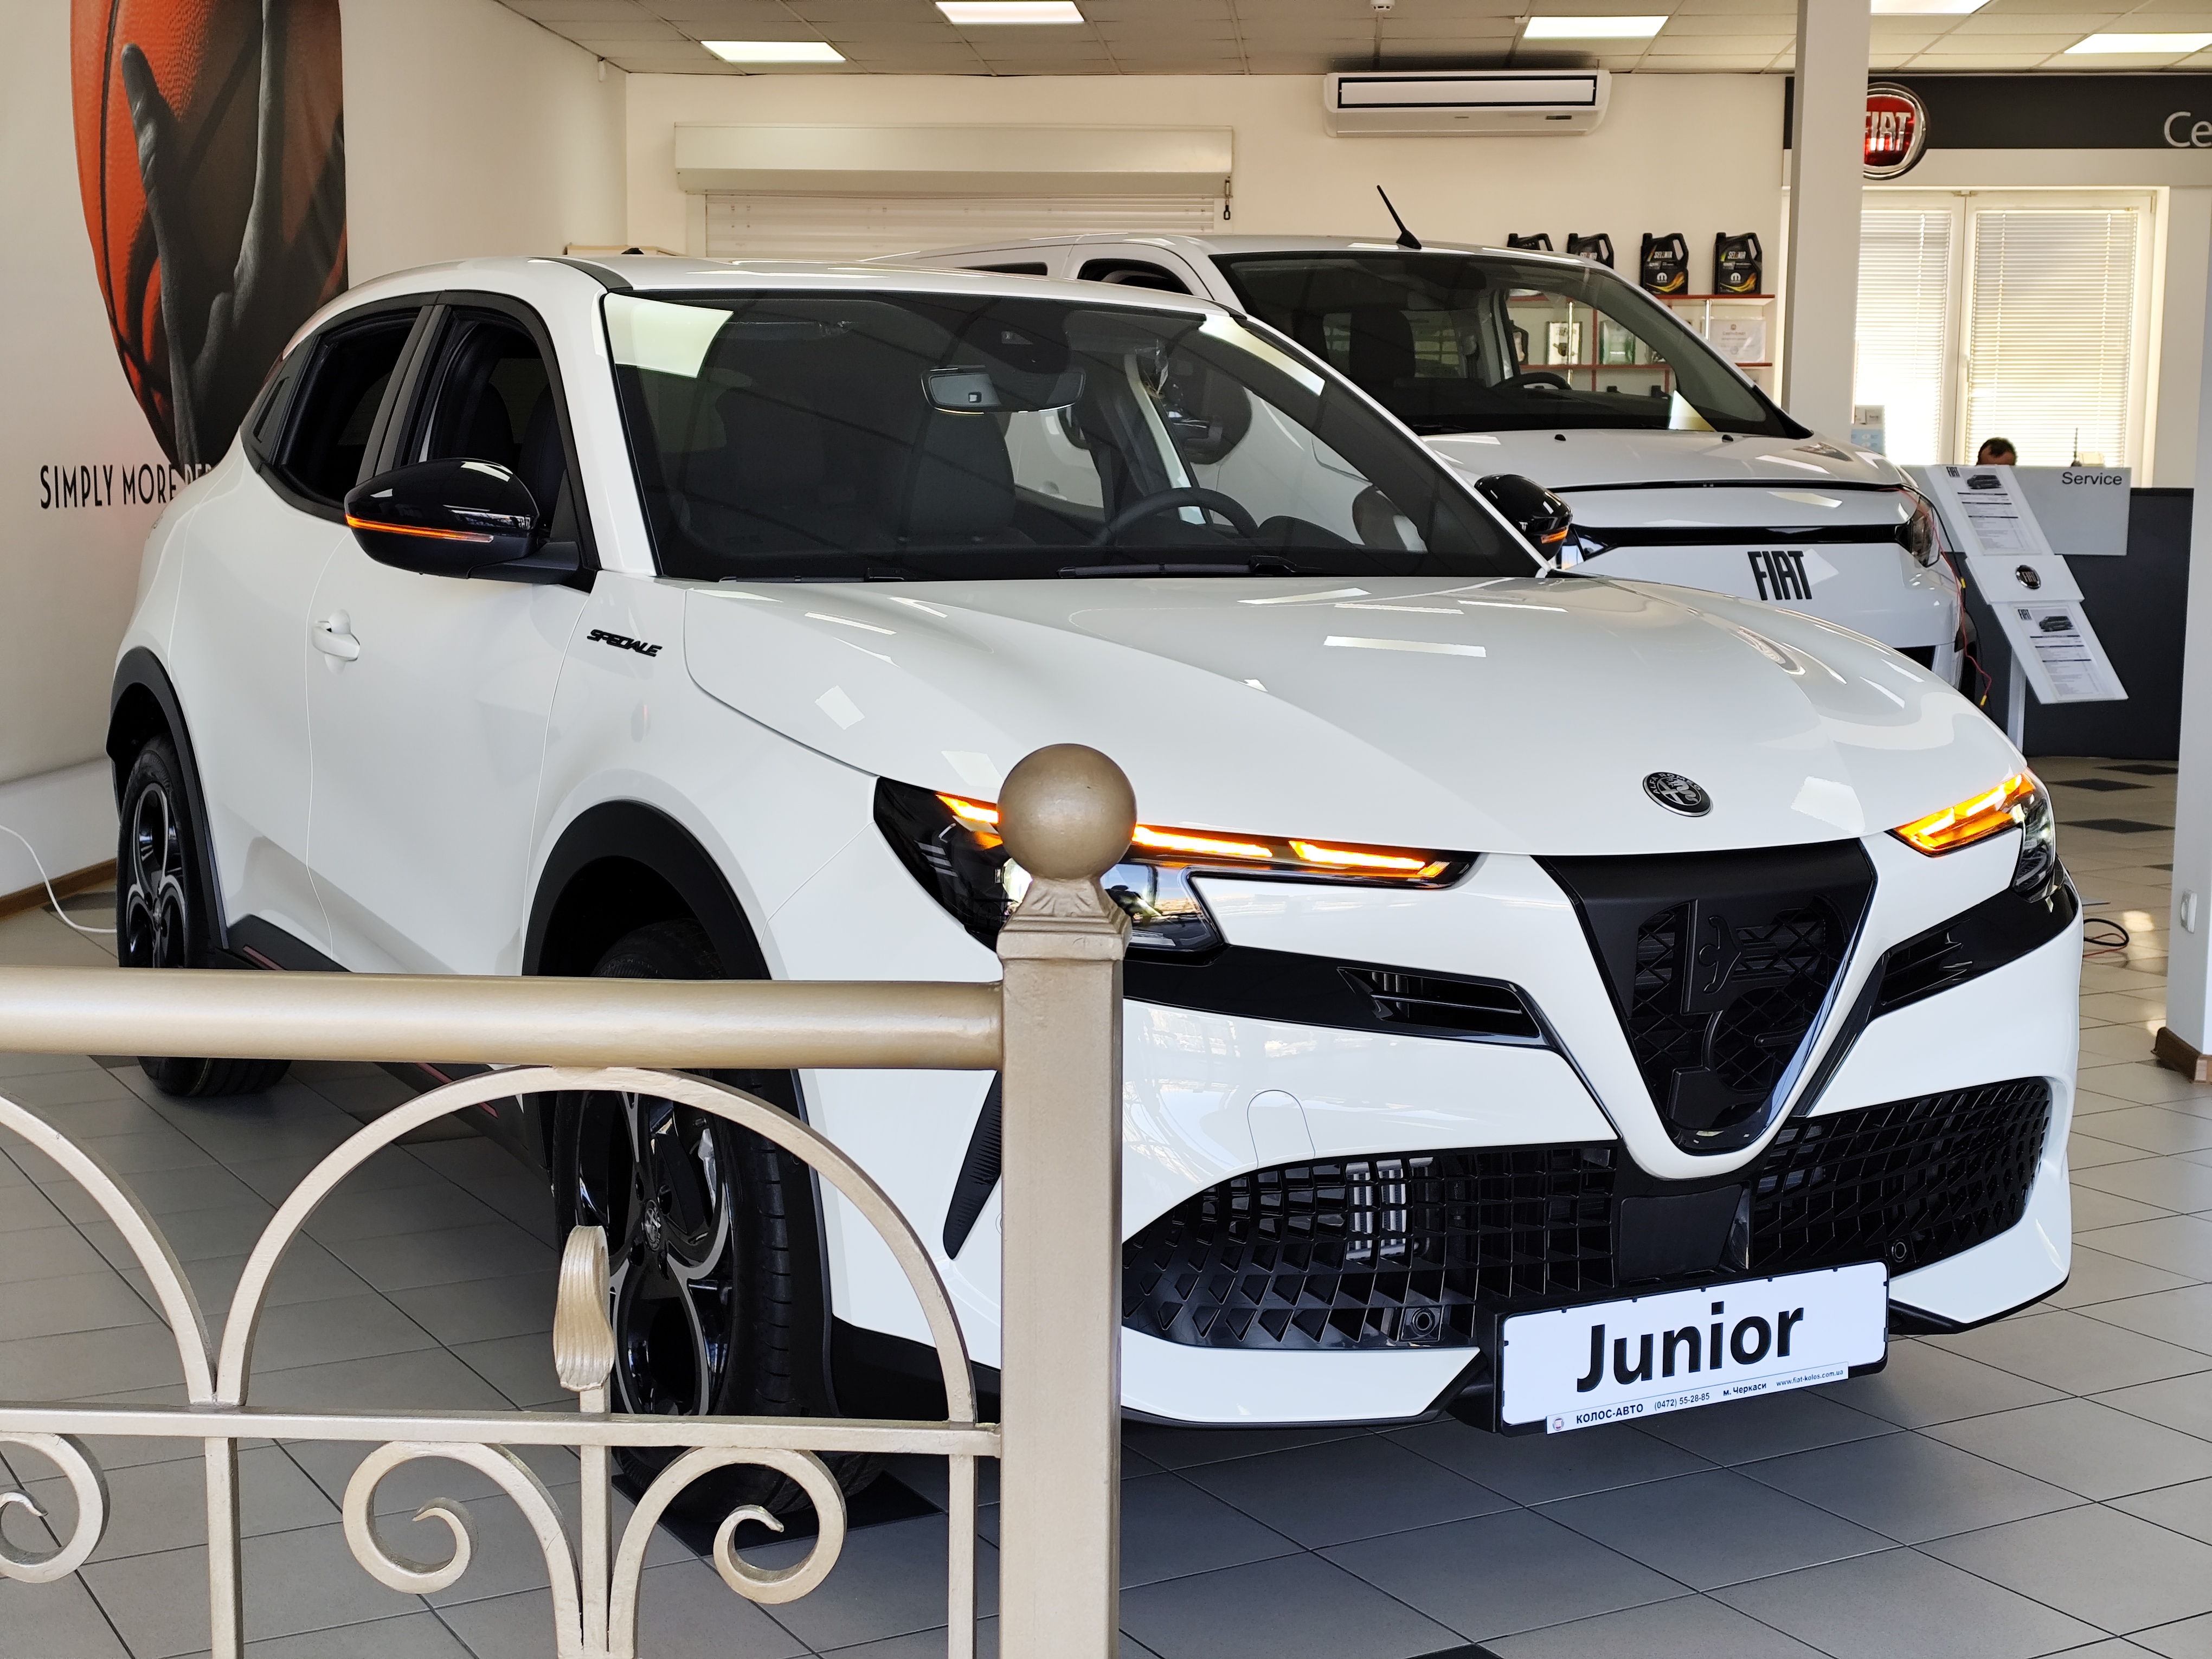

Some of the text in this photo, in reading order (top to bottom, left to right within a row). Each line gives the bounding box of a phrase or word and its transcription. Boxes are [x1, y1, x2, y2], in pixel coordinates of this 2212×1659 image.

[2164, 111, 2212, 147] Ce
[40, 465, 113, 509] SIMPLY
[122, 463, 176, 505] MORE
[2062, 471, 2123, 485] Service
[1747, 550, 1812, 601] FIAT
[1649, 773, 1701, 794] ALFA ROMEO
[1577, 1301, 1804, 1393] Junior
[1776, 1369, 1843, 1386] www.fiat-kolos.com.ua
[1576, 1404, 1643, 1424] КОЛОС-АВТО
[1654, 1398, 1677, 1411] (0472)
[1680, 1392, 1710, 1405] 55-28-85
[1733, 1382, 1767, 1394] Черкаси
